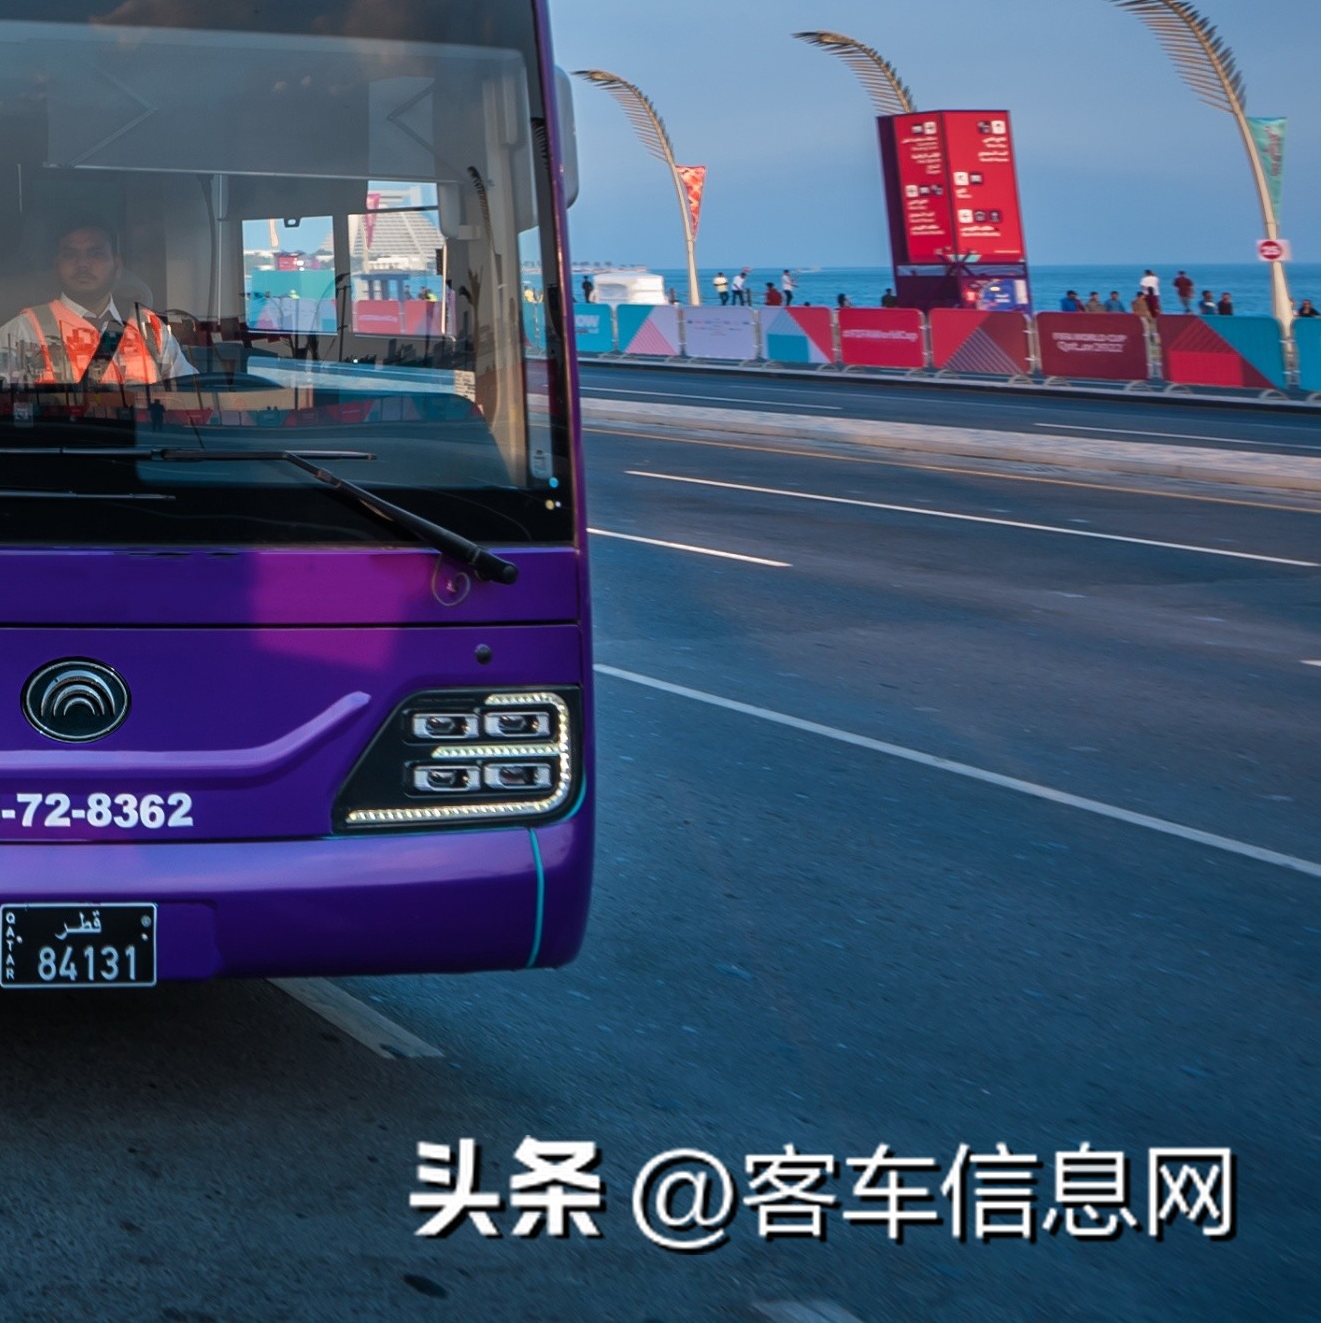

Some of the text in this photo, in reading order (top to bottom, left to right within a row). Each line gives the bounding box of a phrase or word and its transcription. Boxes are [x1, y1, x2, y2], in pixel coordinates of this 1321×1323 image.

[54, 910, 102, 940] قطر
[5, 912, 16, 980] QATAR
[37, 944, 136, 981] 84131
